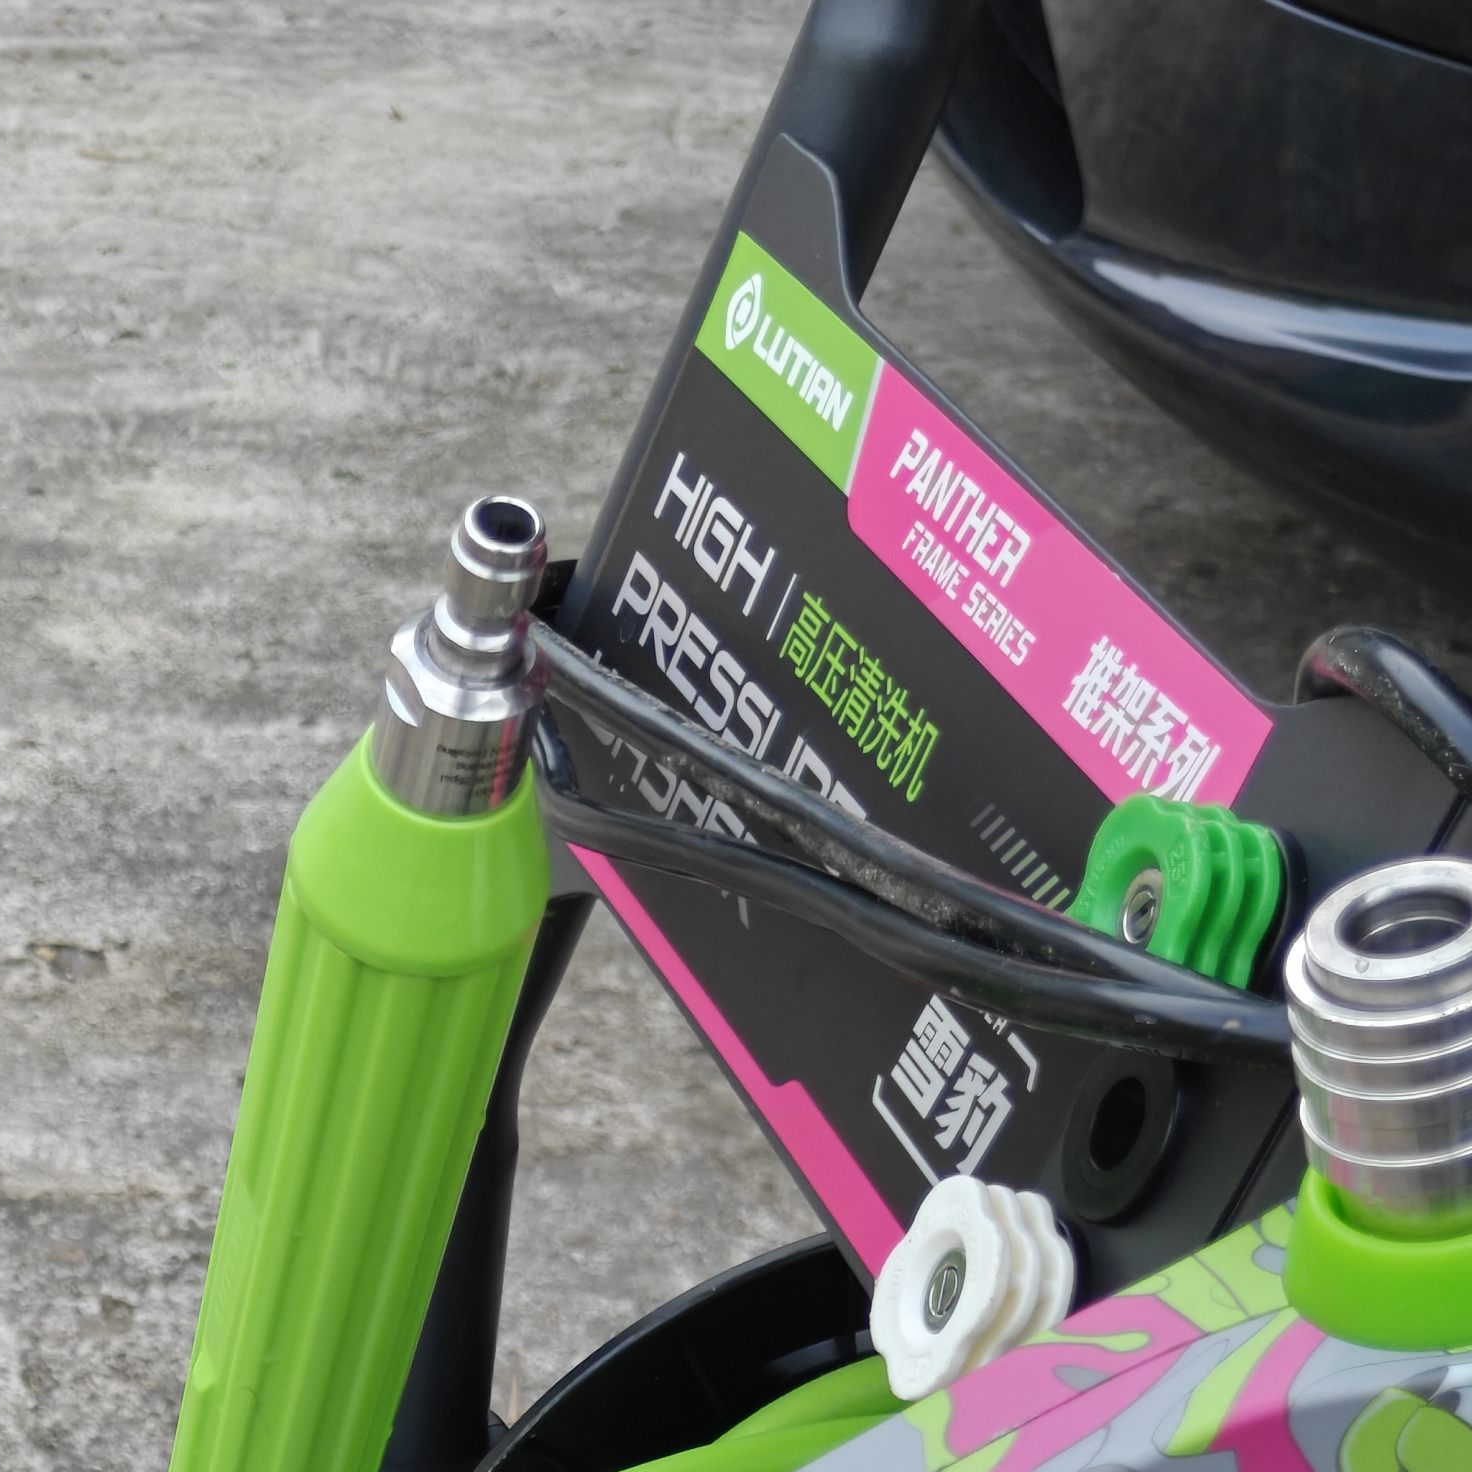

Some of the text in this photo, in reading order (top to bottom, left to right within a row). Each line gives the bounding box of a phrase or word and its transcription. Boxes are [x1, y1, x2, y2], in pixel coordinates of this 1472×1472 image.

[753, 314, 854, 433] LUTIAN
[654, 451, 778, 617] HIGH
[889, 429, 1032, 587] PANTHER
[901, 520, 1037, 668] FRAME SERIES
[779, 591, 940, 802] 高压清洗机
[1061, 636, 1221, 801] 推架系列
[890, 994, 1012, 1177] 雪豹
